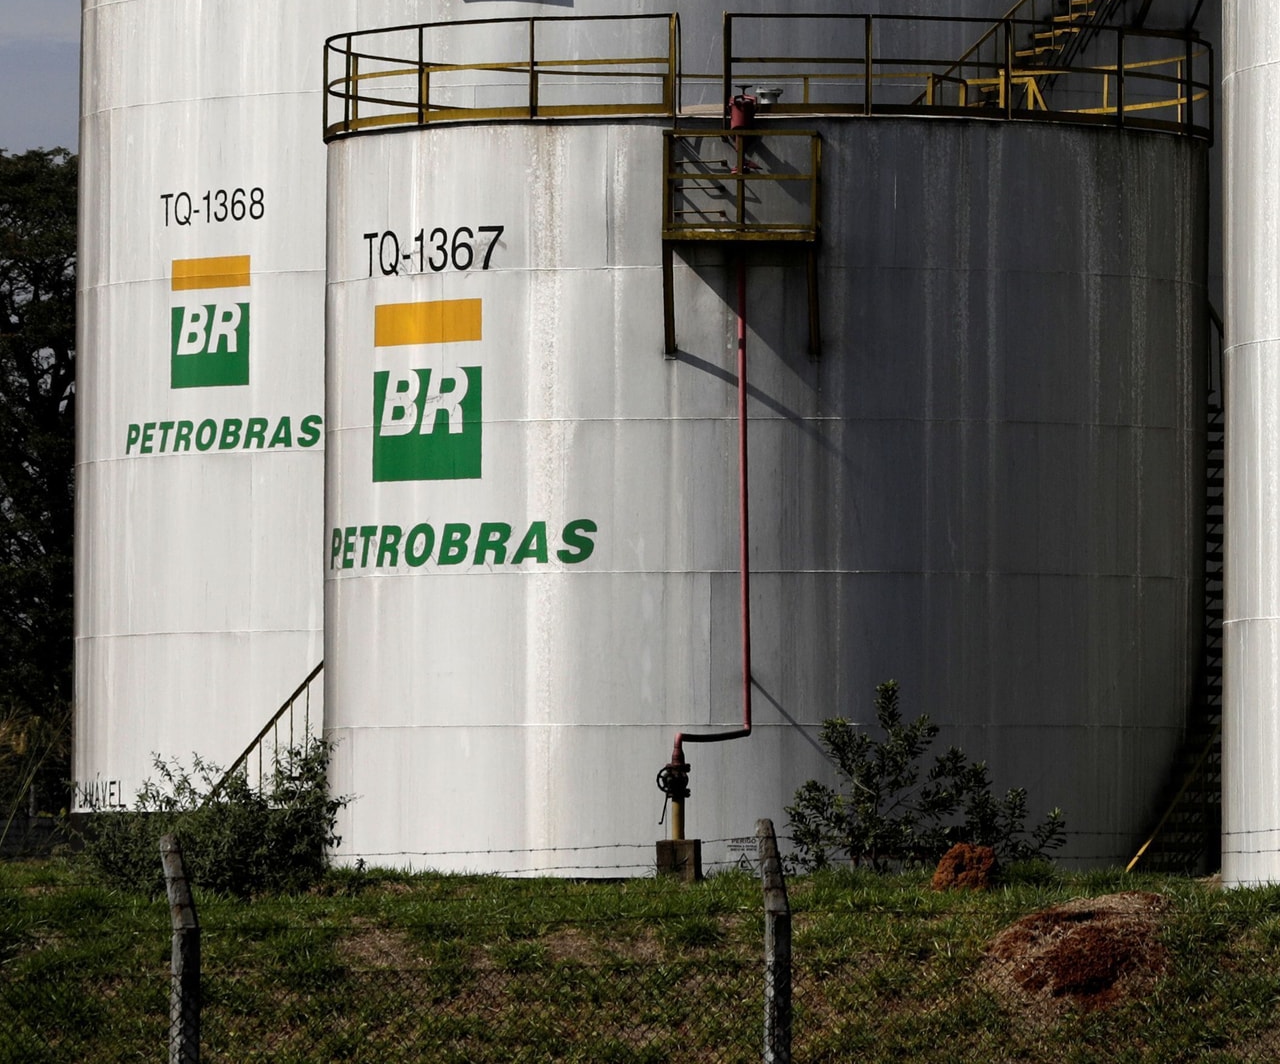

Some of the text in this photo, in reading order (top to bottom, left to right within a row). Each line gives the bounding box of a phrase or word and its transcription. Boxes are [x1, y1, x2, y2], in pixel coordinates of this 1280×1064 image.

[160, 187, 265, 227] TQ-1368
[363, 225, 505, 278] TQ-1367
[175, 303, 242, 356] BR
[378, 367, 470, 437] BR
[126, 414, 323, 455] PETROBRAS
[330, 518, 598, 571] PETROBRAS
